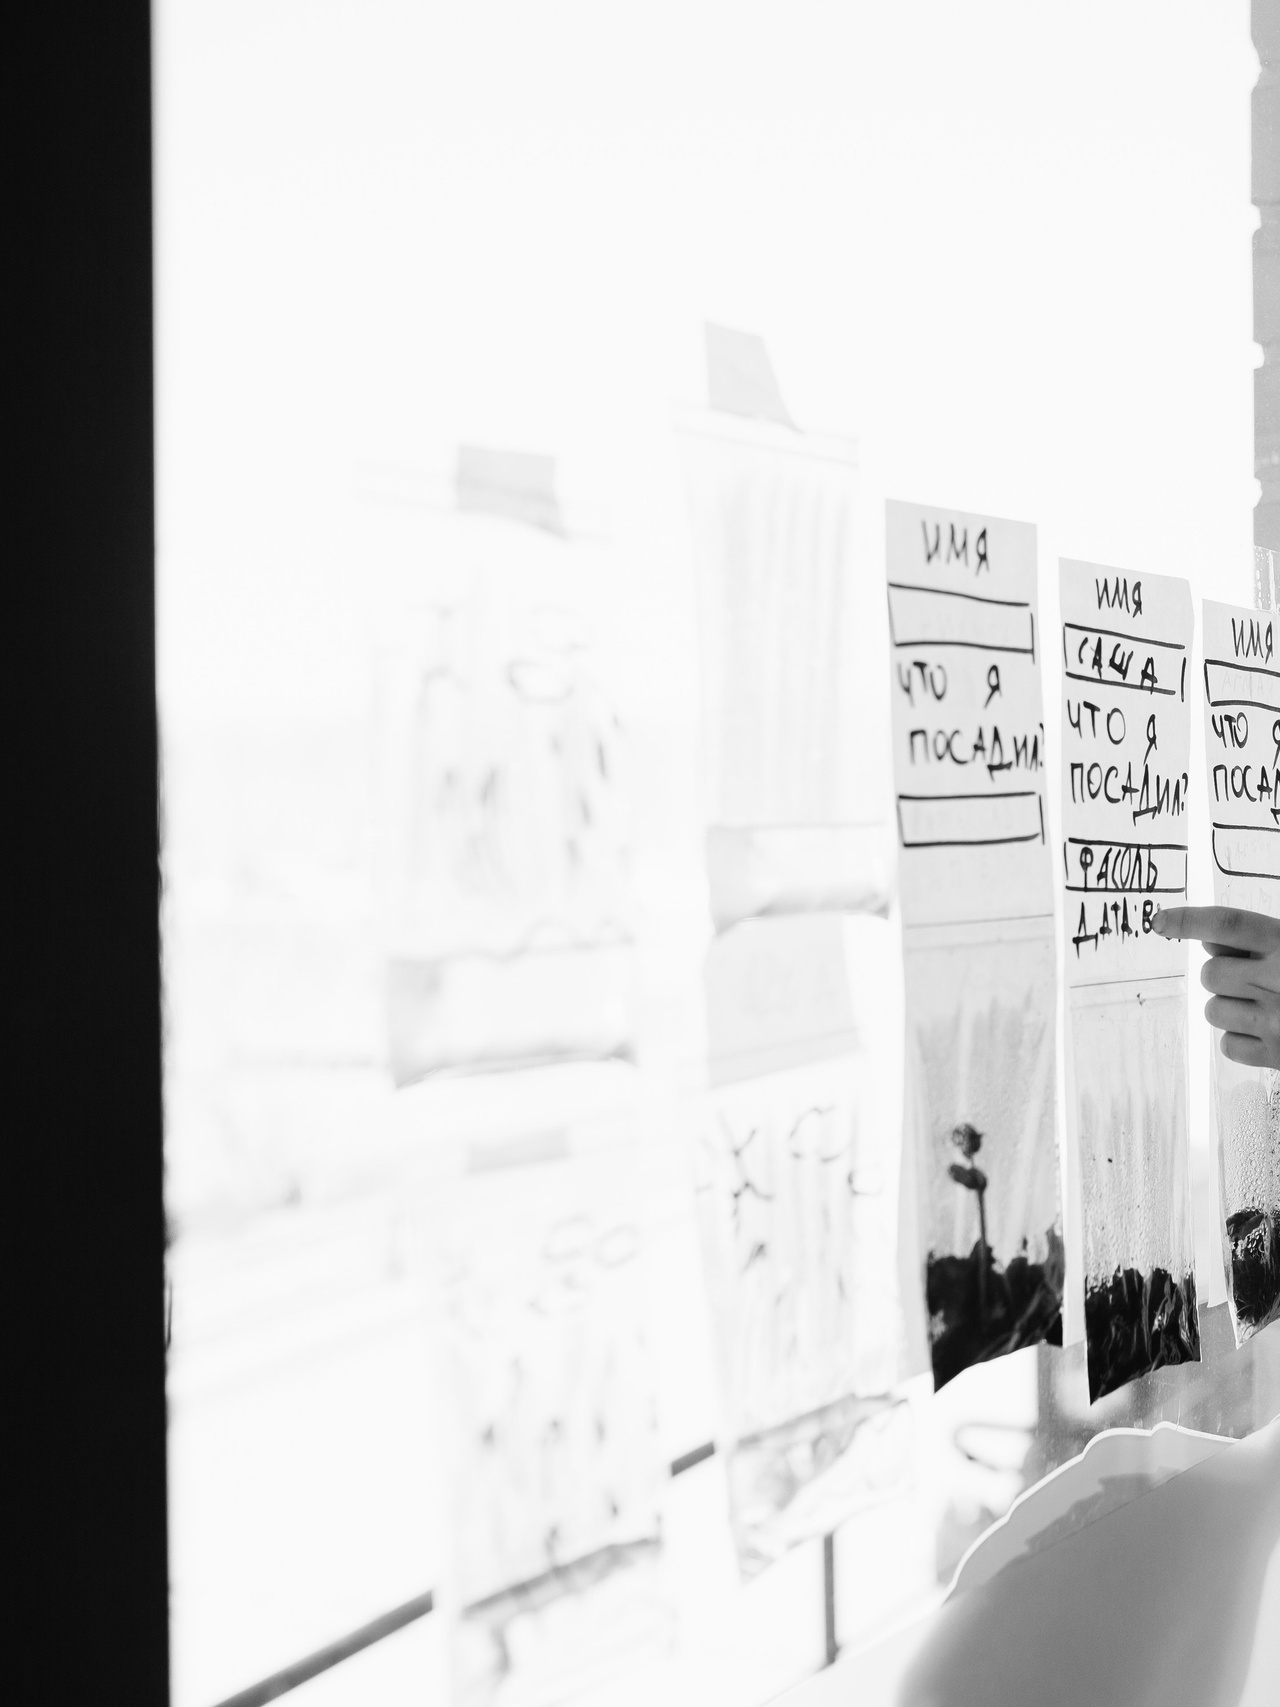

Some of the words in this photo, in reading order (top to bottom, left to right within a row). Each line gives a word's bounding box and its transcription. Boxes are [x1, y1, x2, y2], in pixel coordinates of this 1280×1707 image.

[921, 519, 990, 577] ИМЯ
[1095, 576, 1143, 618] ИМЯ
[1078, 636, 1158, 695] САША
[1231, 617, 1274, 665] ИМЯ
[897, 660, 948, 708] ЧТО
[984, 664, 1003, 709] Я
[909, 722, 1045, 783] ПОСАДИЛ?
[1067, 699, 1126, 745] ЧТО
[1143, 714, 1158, 765] Я
[1211, 711, 1249, 749] ЧТО
[1070, 760, 1189, 827] ПОСАДИЛ?
[1079, 844, 1158, 893] ФАСОЛЬ
